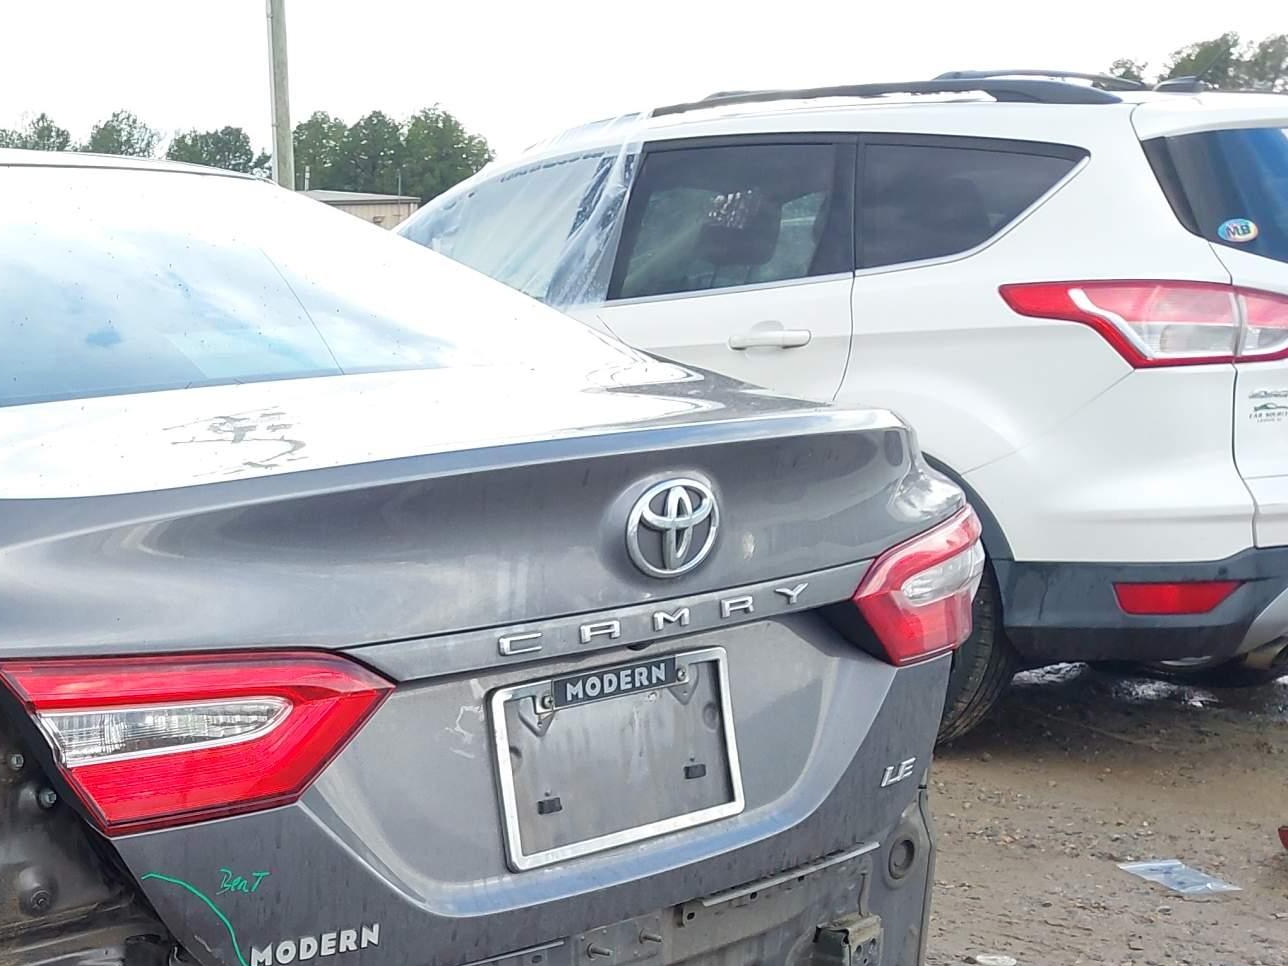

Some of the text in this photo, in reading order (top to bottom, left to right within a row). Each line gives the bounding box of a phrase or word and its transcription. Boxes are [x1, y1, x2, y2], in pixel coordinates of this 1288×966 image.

[498, 582, 810, 656] CAMRY
[565, 663, 666, 701] MODERN
[880, 757, 917, 788] LE
